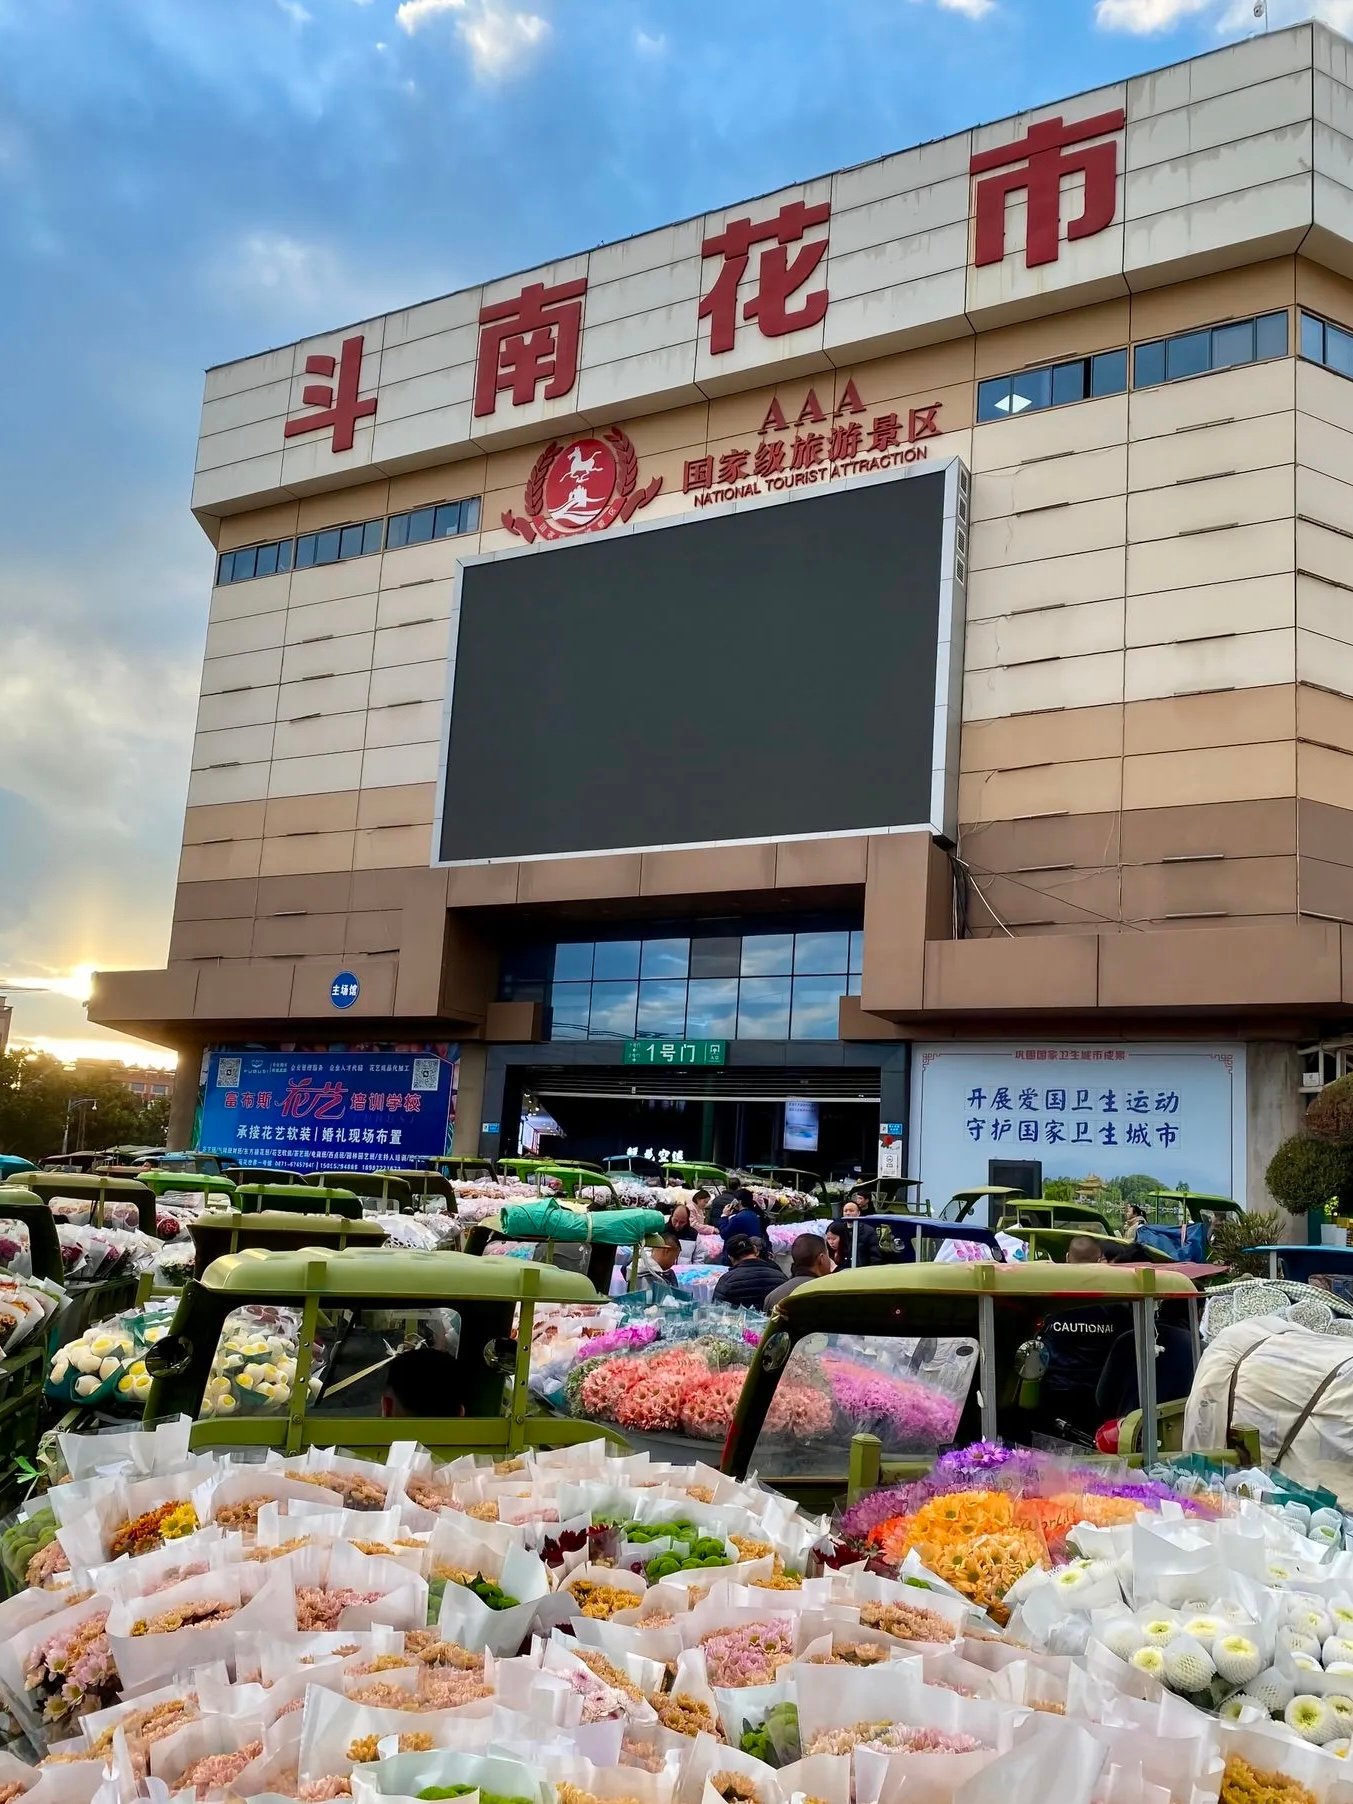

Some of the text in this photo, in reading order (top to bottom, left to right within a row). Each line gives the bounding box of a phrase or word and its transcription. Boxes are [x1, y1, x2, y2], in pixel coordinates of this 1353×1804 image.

[285, 109, 1126, 452] 斗南花市
[682, 401, 944, 494] 国家级旅游景区
[693, 445, 928, 507] NATIONAL TOURIST ATTRACTION
[646, 1043, 696, 1063] 1号门
[966, 1087, 1180, 1114] 开展爱国卫生运动
[966, 1118, 1180, 1148] 守护国家卫生城市
